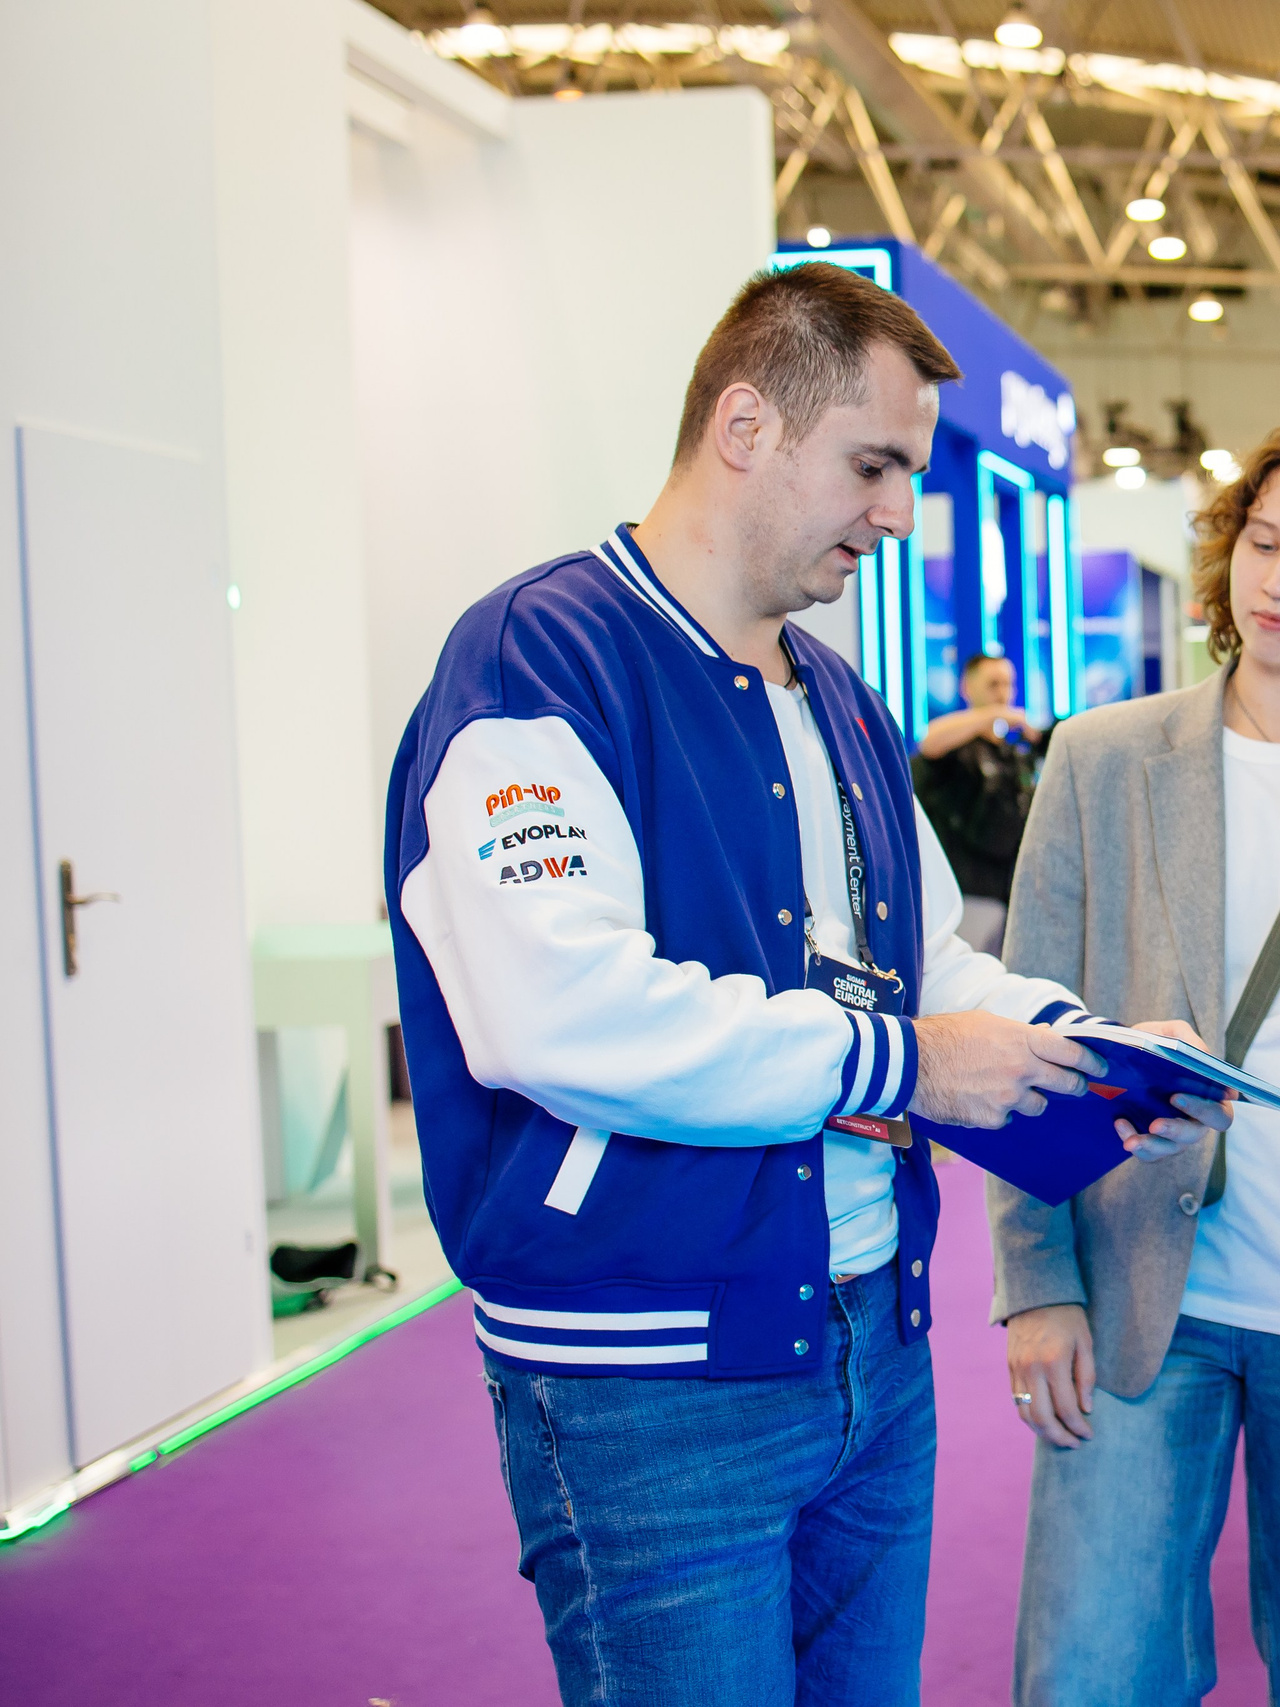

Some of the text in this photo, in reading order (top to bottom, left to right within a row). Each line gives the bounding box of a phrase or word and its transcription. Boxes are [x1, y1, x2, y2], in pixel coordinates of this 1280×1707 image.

[501, 825, 587, 850] EVOPLAY
[849, 865, 863, 920] Center
[833, 977, 878, 1002] CENTRAL
[834, 989, 874, 1011] EUROPE
